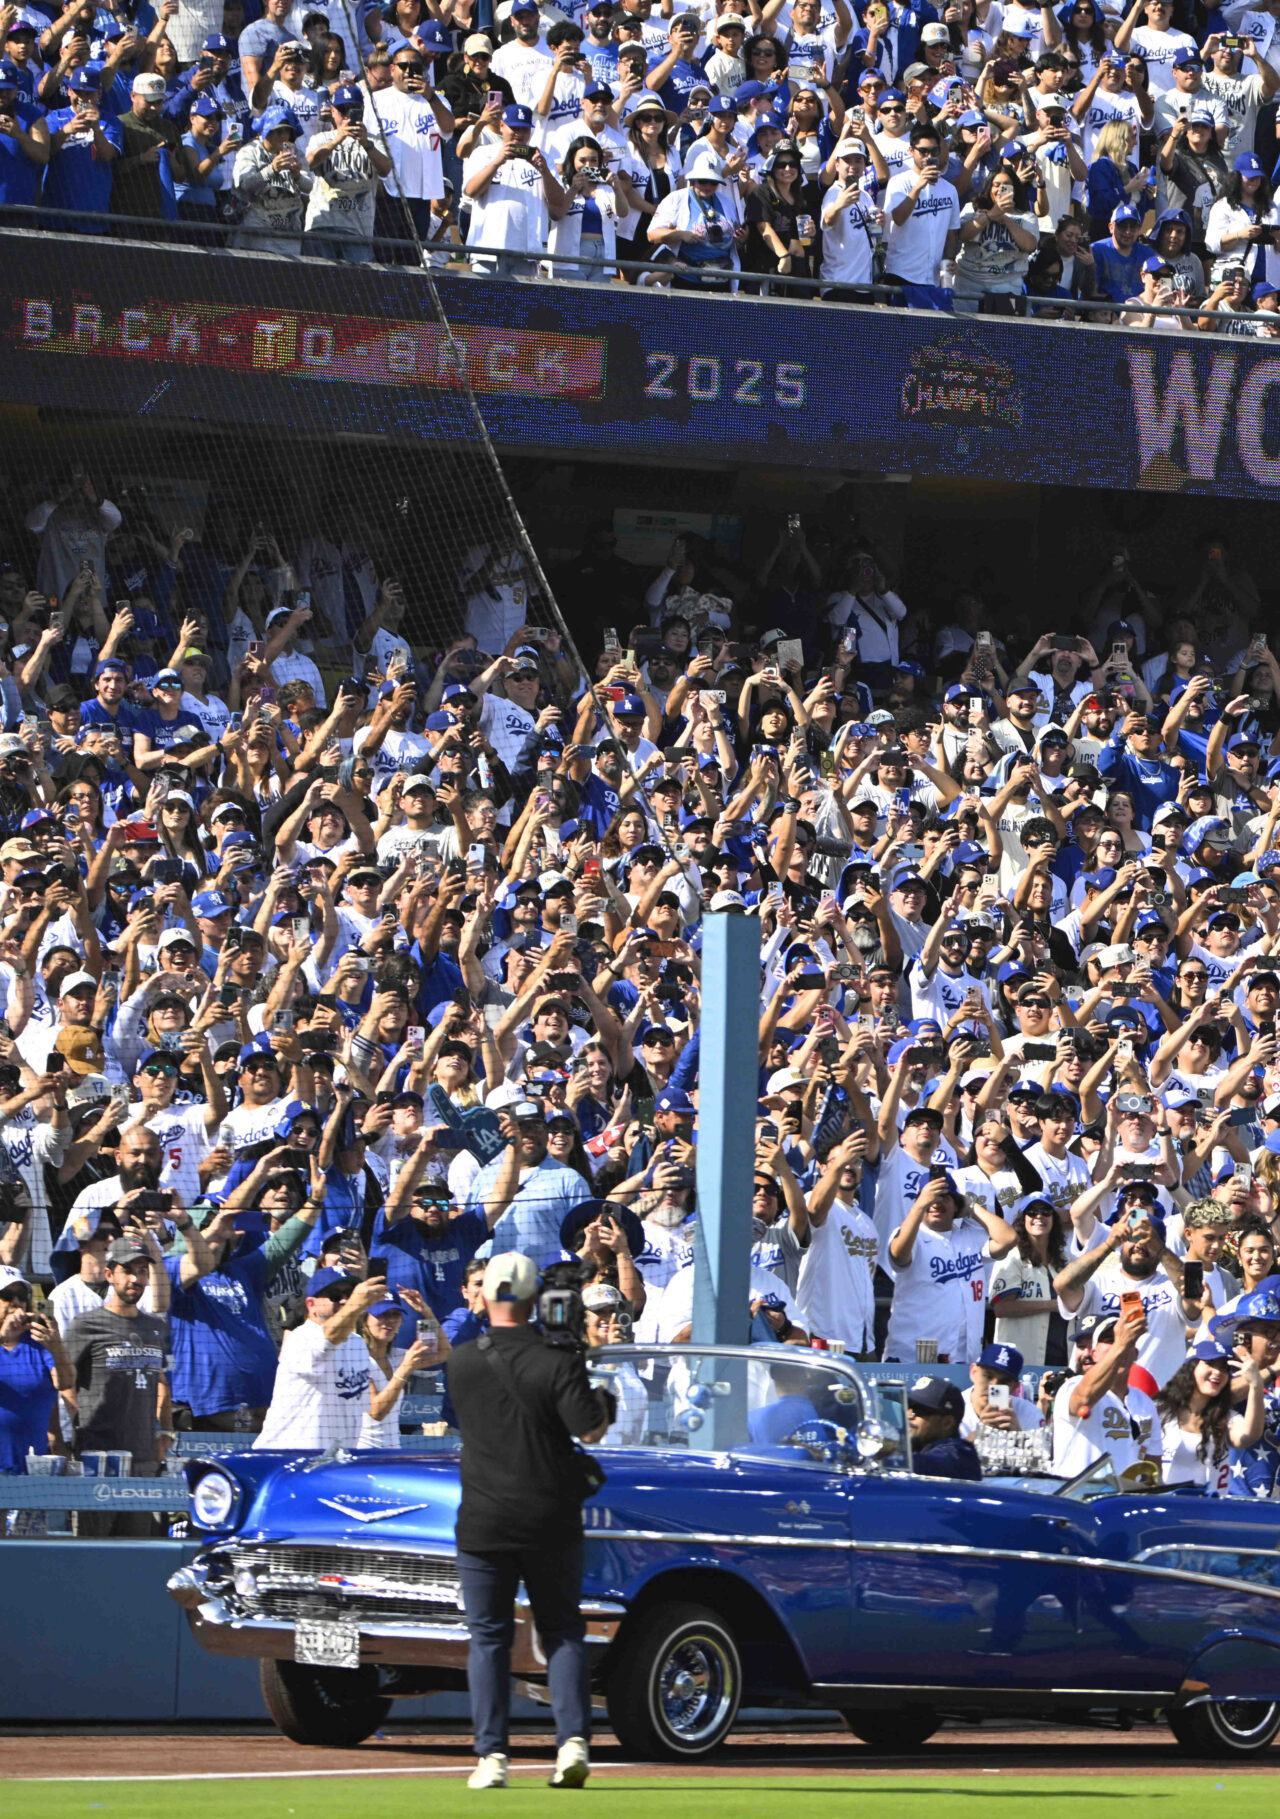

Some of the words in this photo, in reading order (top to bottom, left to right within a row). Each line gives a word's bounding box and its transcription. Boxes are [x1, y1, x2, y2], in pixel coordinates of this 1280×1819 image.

[913, 196, 952, 218] Dodgers
[645, 351, 807, 407] 2025
[896, 797, 910, 815] LA
[477, 1127, 501, 1155] LA
[169, 1147, 182, 1170] 5
[931, 1252, 982, 1283] Dodgers
[970, 1280, 984, 1301] 18
[415, 1405, 441, 1414] LEX
[186, 1441, 235, 1453] LEXUS
[112, 1488, 163, 1499] LEXUS
